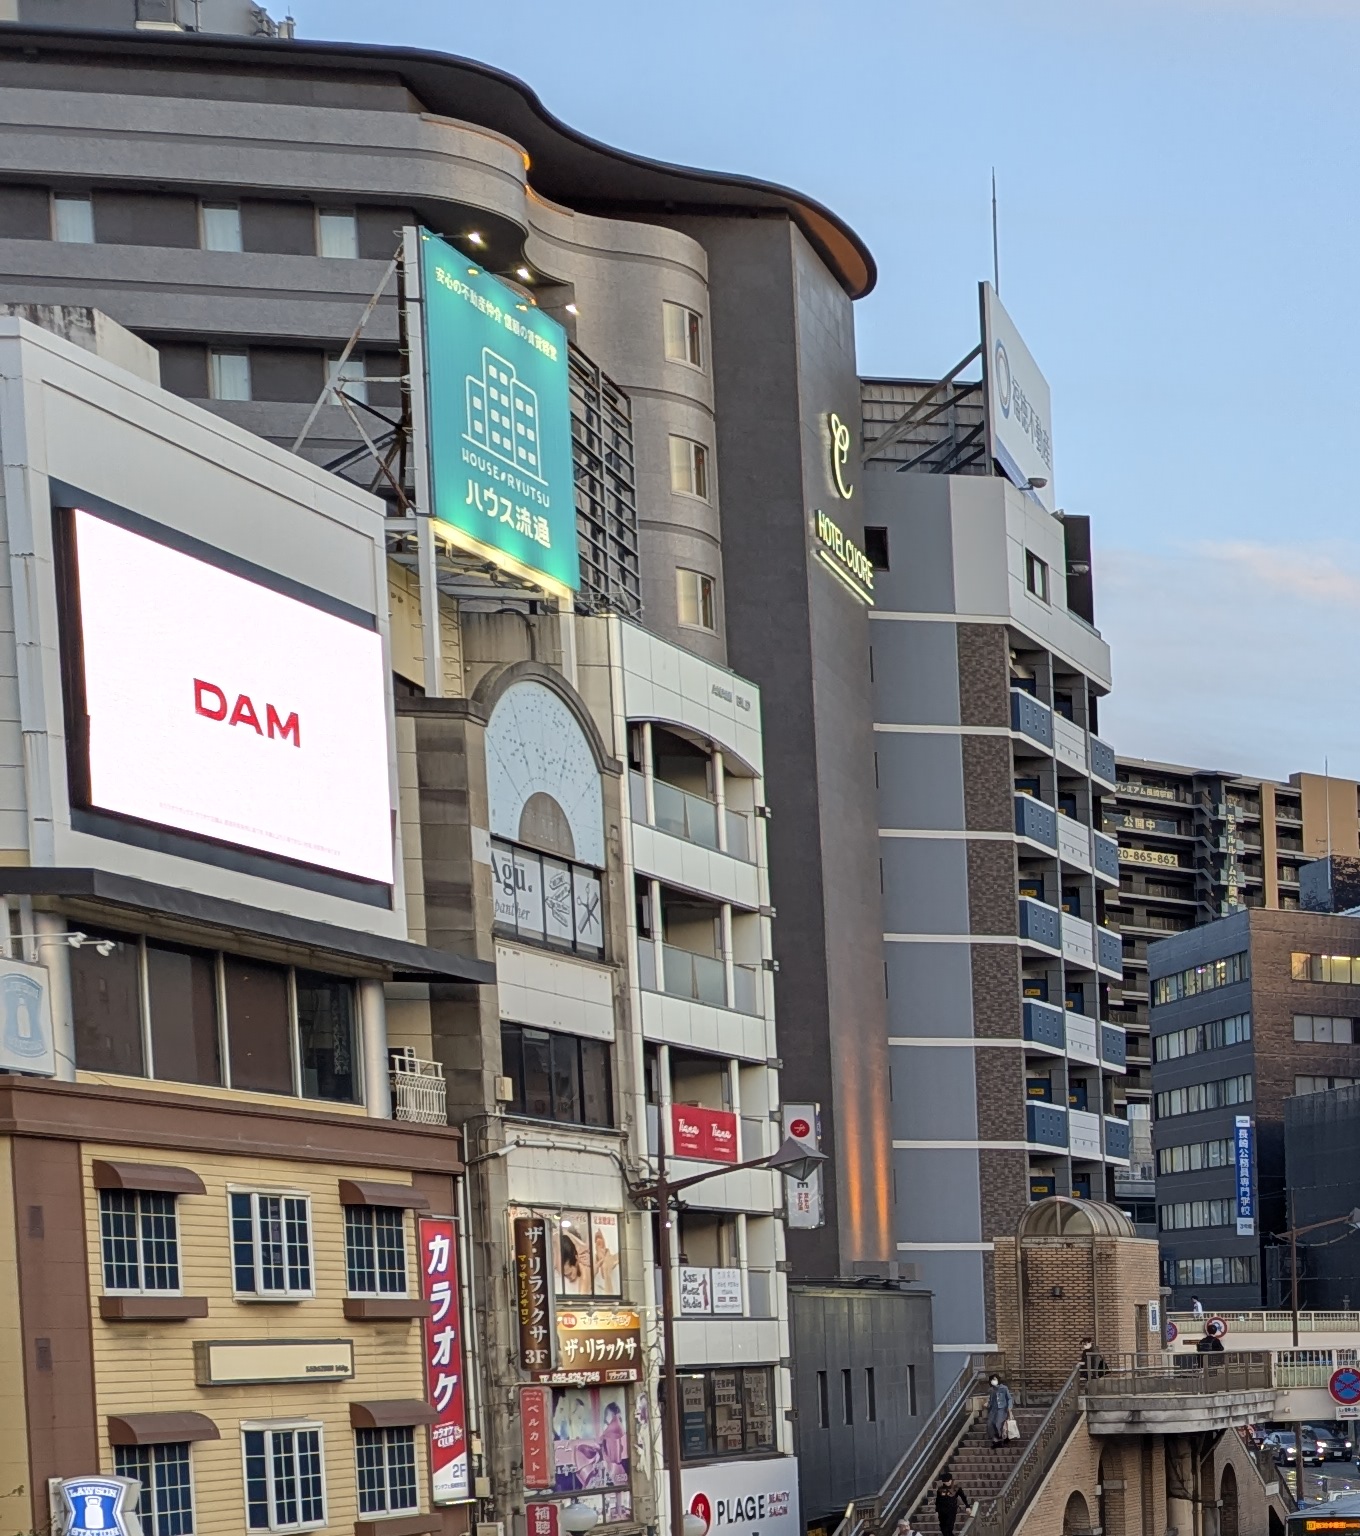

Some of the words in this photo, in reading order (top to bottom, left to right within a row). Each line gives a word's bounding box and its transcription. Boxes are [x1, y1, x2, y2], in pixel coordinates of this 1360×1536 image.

[462, 447, 500, 482] HOUSE
[506, 477, 550, 508] RYUTSU
[466, 479, 551, 549] ハウス流通
[818, 510, 846, 561] HOTEL
[845, 540, 874, 590] CUORE
[193, 677, 301, 748] DAM
[517, 1254, 530, 1325] マッサージサロン
[524, 1226, 548, 1344] ザ・リラックサ
[427, 1234, 459, 1412] カラオケ
[564, 1337, 638, 1363] ザ・リラックサ
[525, 1350, 548, 1364] 3F
[452, 1464, 467, 1479] 2F
[528, 1405, 540, 1472] ベルカント
[68, 1486, 118, 1499] LAWSON
[716, 1495, 766, 1526] PLAGE
